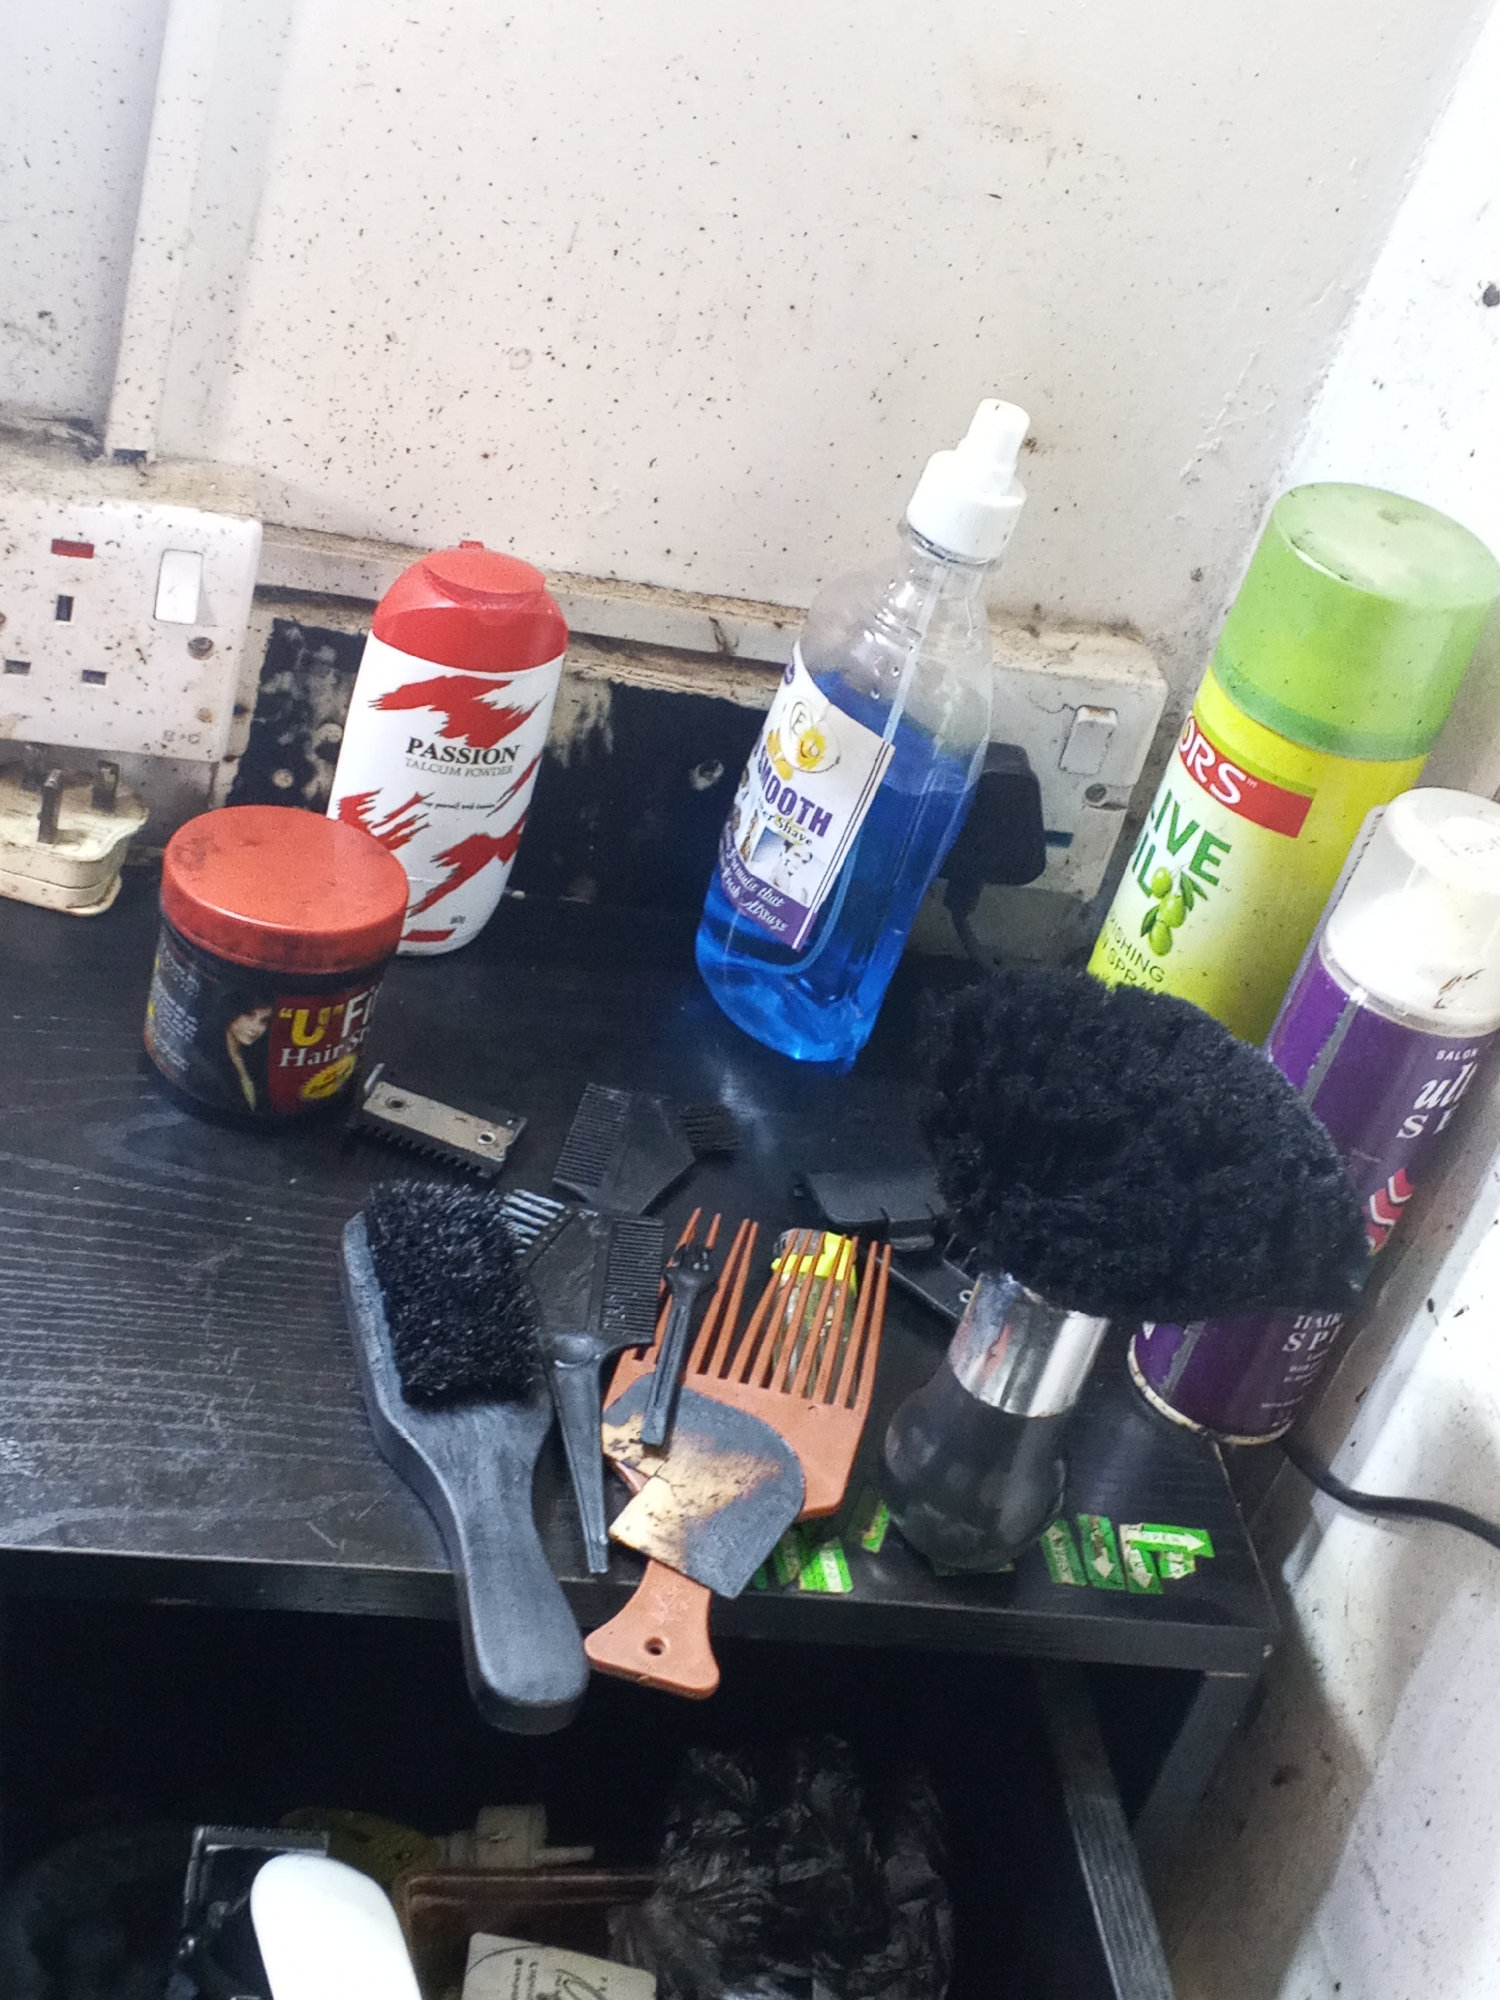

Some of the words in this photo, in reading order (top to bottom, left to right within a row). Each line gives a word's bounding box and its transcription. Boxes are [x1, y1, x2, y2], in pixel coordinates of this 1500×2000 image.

[405, 736, 521, 765] PASSION
[404, 756, 461, 777] TALCUM
[778, 817, 813, 846] Shave
[1151, 788, 1232, 887] IVE
[279, 1044, 344, 1067] Hair
